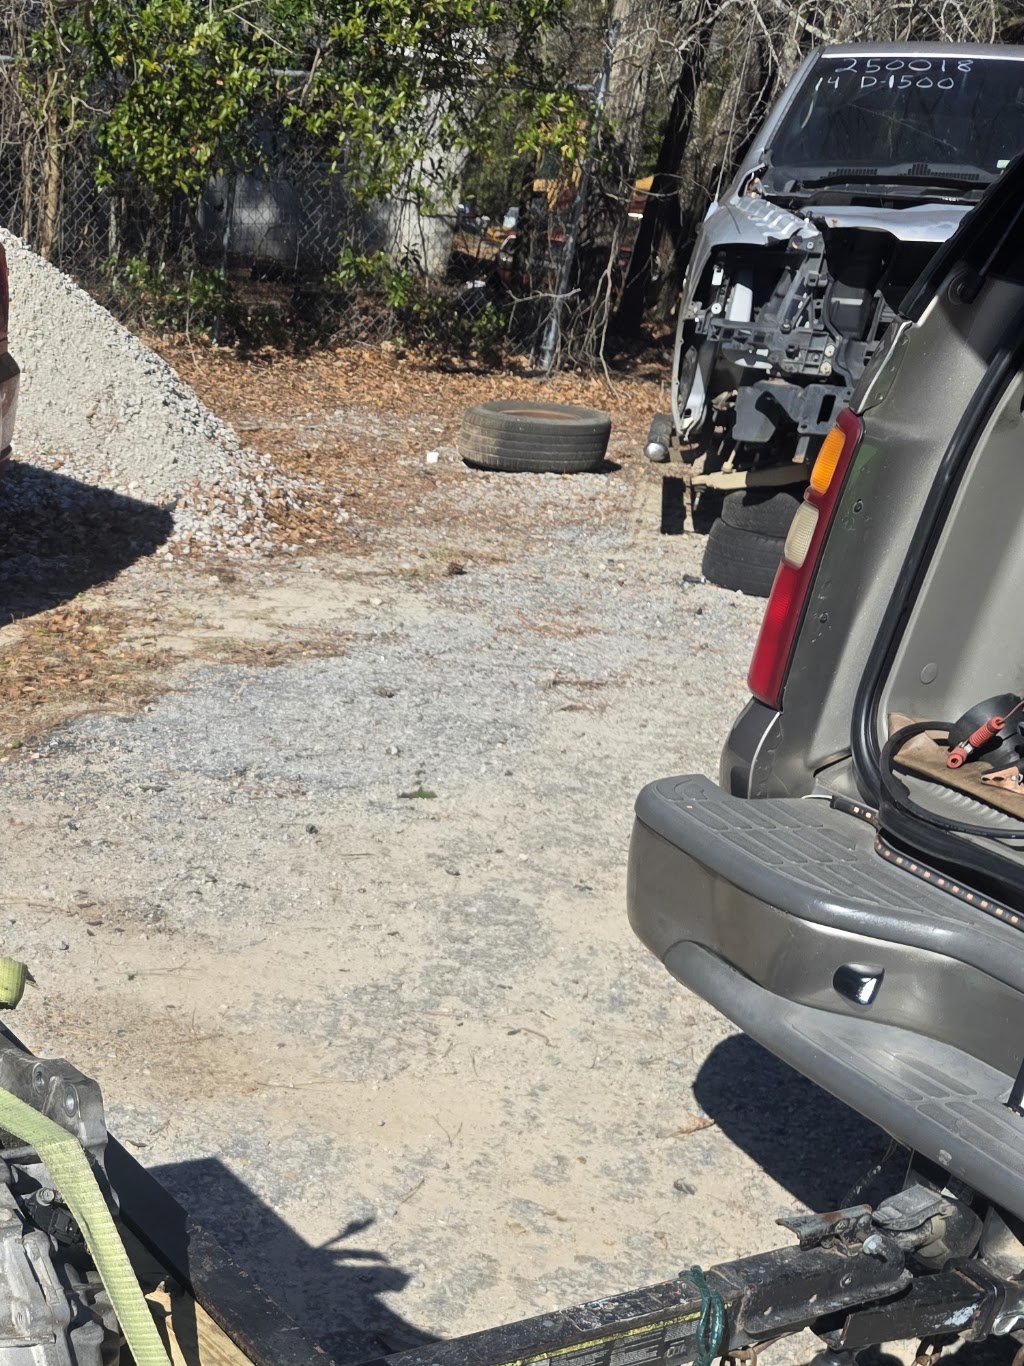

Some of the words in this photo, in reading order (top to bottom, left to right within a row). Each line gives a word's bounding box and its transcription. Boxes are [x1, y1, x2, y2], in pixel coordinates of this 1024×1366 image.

[834, 58, 974, 74] 250018
[814, 76, 840, 91] 14
[860, 74, 956, 90] D-1500
